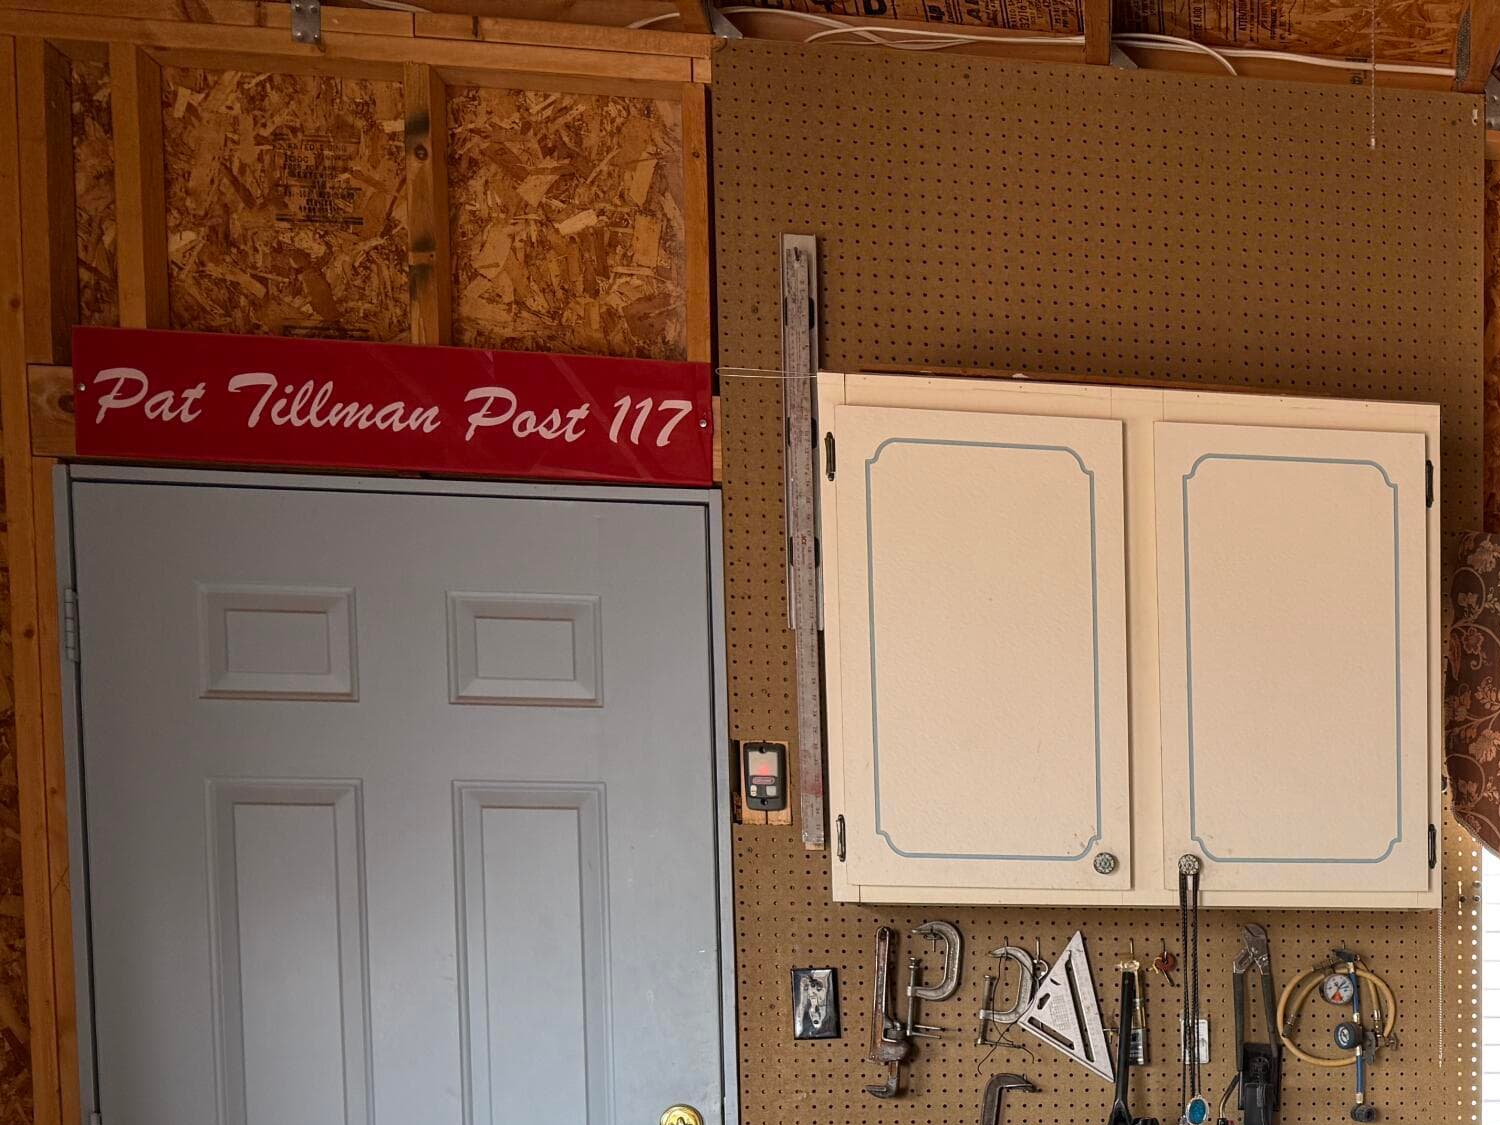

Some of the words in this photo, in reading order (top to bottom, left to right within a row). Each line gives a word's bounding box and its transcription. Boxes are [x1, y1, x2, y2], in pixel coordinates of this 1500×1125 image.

[93, 367, 206, 425] Pat
[228, 373, 441, 433] Tillman
[464, 387, 591, 443] Post
[608, 400, 693, 447] 117
